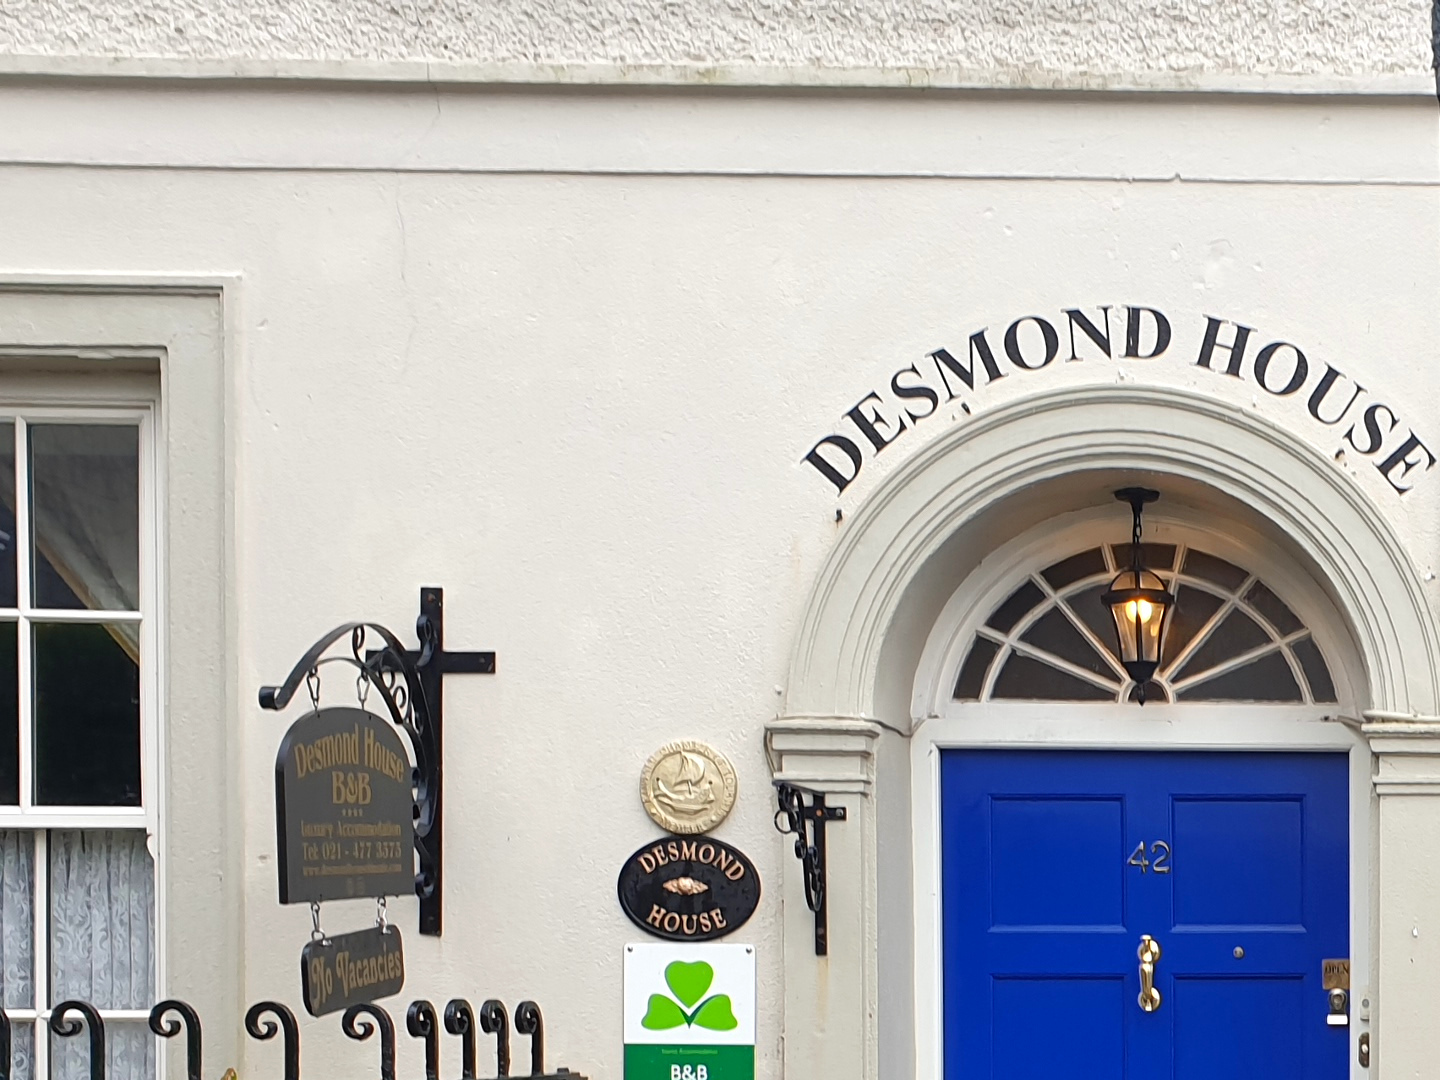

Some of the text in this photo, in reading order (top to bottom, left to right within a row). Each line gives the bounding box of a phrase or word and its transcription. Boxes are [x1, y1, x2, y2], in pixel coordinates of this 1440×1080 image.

[801, 303, 1438, 496] DESMOND HOUSE
[294, 722, 404, 783] Desmond House
[331, 770, 372, 805] B&B
[322, 842, 341, 860] 021
[353, 841, 372, 860] 477
[637, 840, 745, 881] DESMOND
[1127, 840, 1170, 874] 42
[646, 903, 727, 935] HOUSE
[311, 942, 401, 1011] No Vacancies
